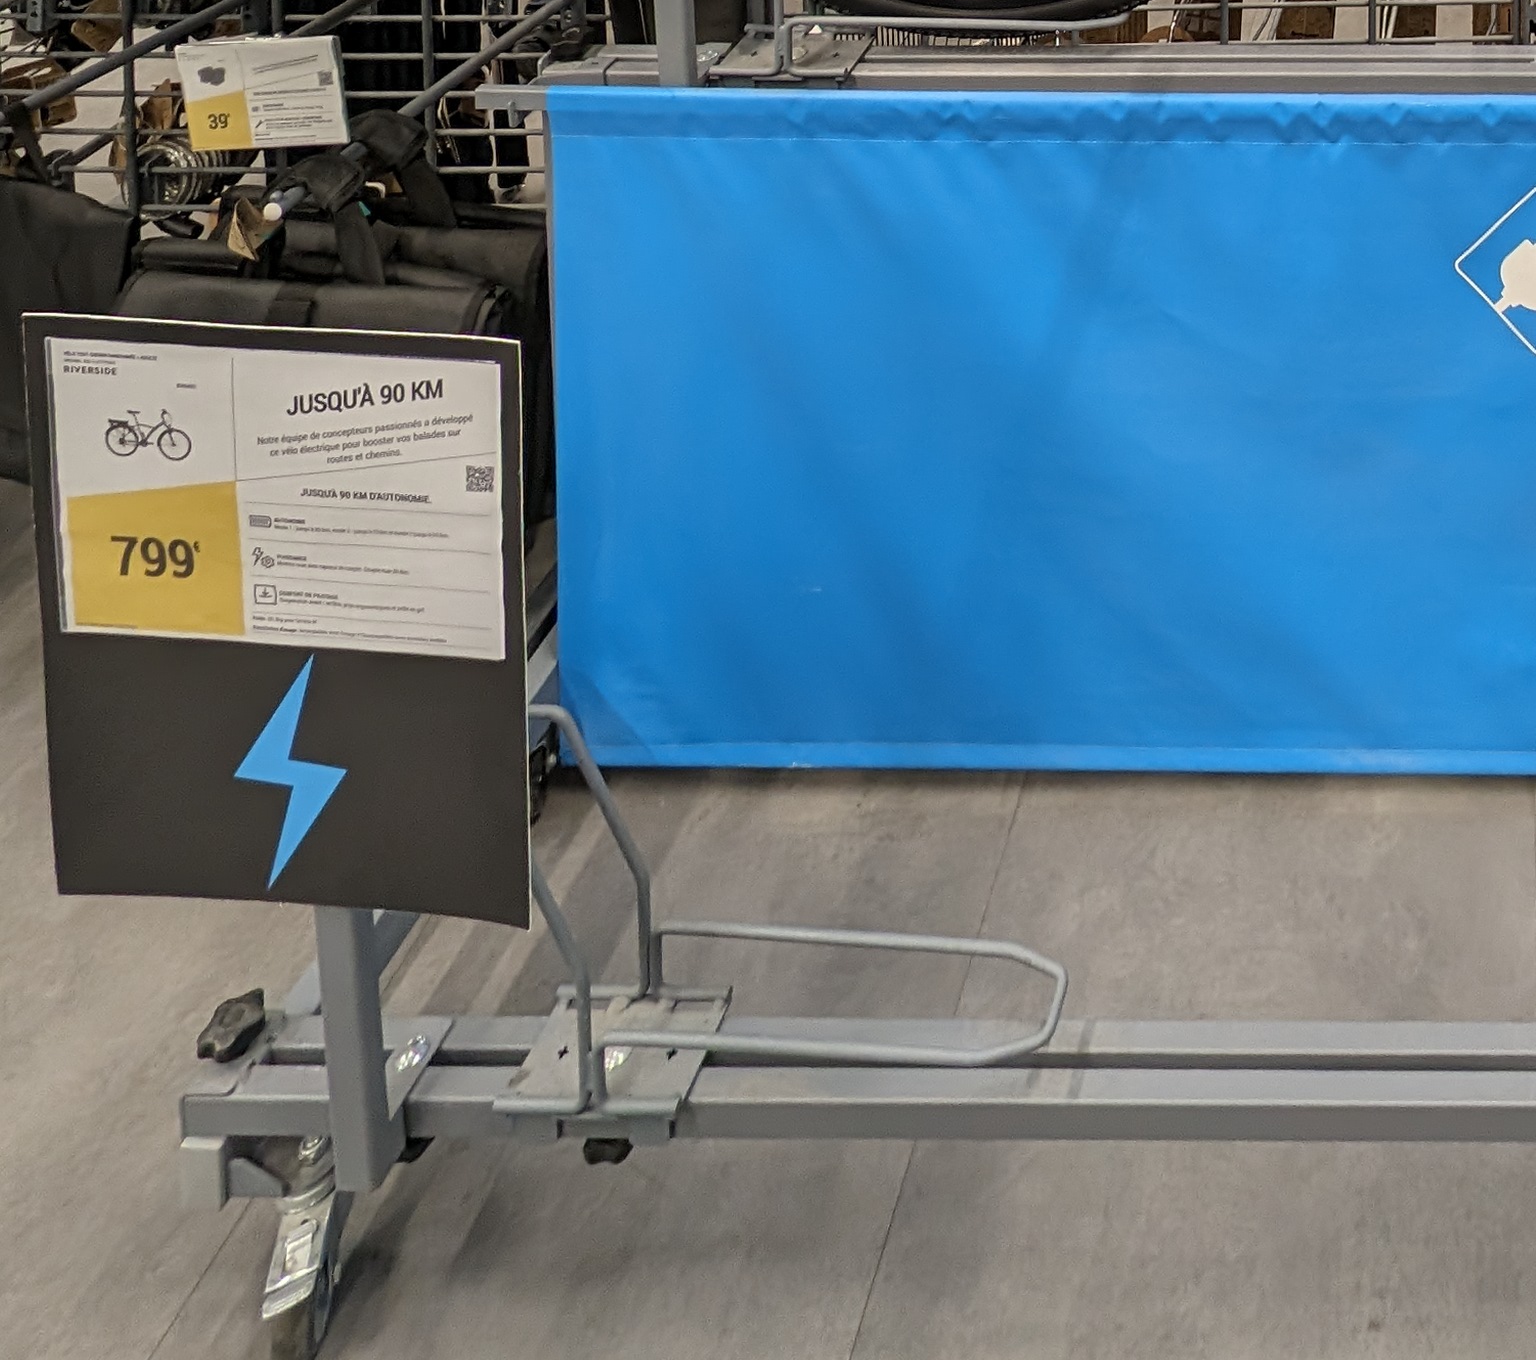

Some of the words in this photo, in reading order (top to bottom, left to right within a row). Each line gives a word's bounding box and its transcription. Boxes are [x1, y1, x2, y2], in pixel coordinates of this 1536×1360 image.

[63, 365, 117, 376] RIVERSIDE
[286, 383, 375, 416] JUSQU'À
[380, 382, 405, 405] 90
[411, 378, 444, 402] KM
[257, 435, 280, 446] Notre
[280, 432, 308, 445] équipe
[310, 430, 321, 441] de
[322, 425, 373, 440] concepteurs
[375, 418, 423, 434] passionnés
[431, 413, 474, 427] développé
[281, 445, 299, 456] vélo
[299, 441, 341, 456] électrique
[342, 440, 361, 452] pour
[362, 435, 395, 448] booster
[395, 435, 412, 443] vos
[413, 430, 446, 442] balades
[447, 429, 462, 438] sur
[355, 452, 364, 461] et
[339, 490, 351, 500] 90
[352, 491, 368, 500] KM
